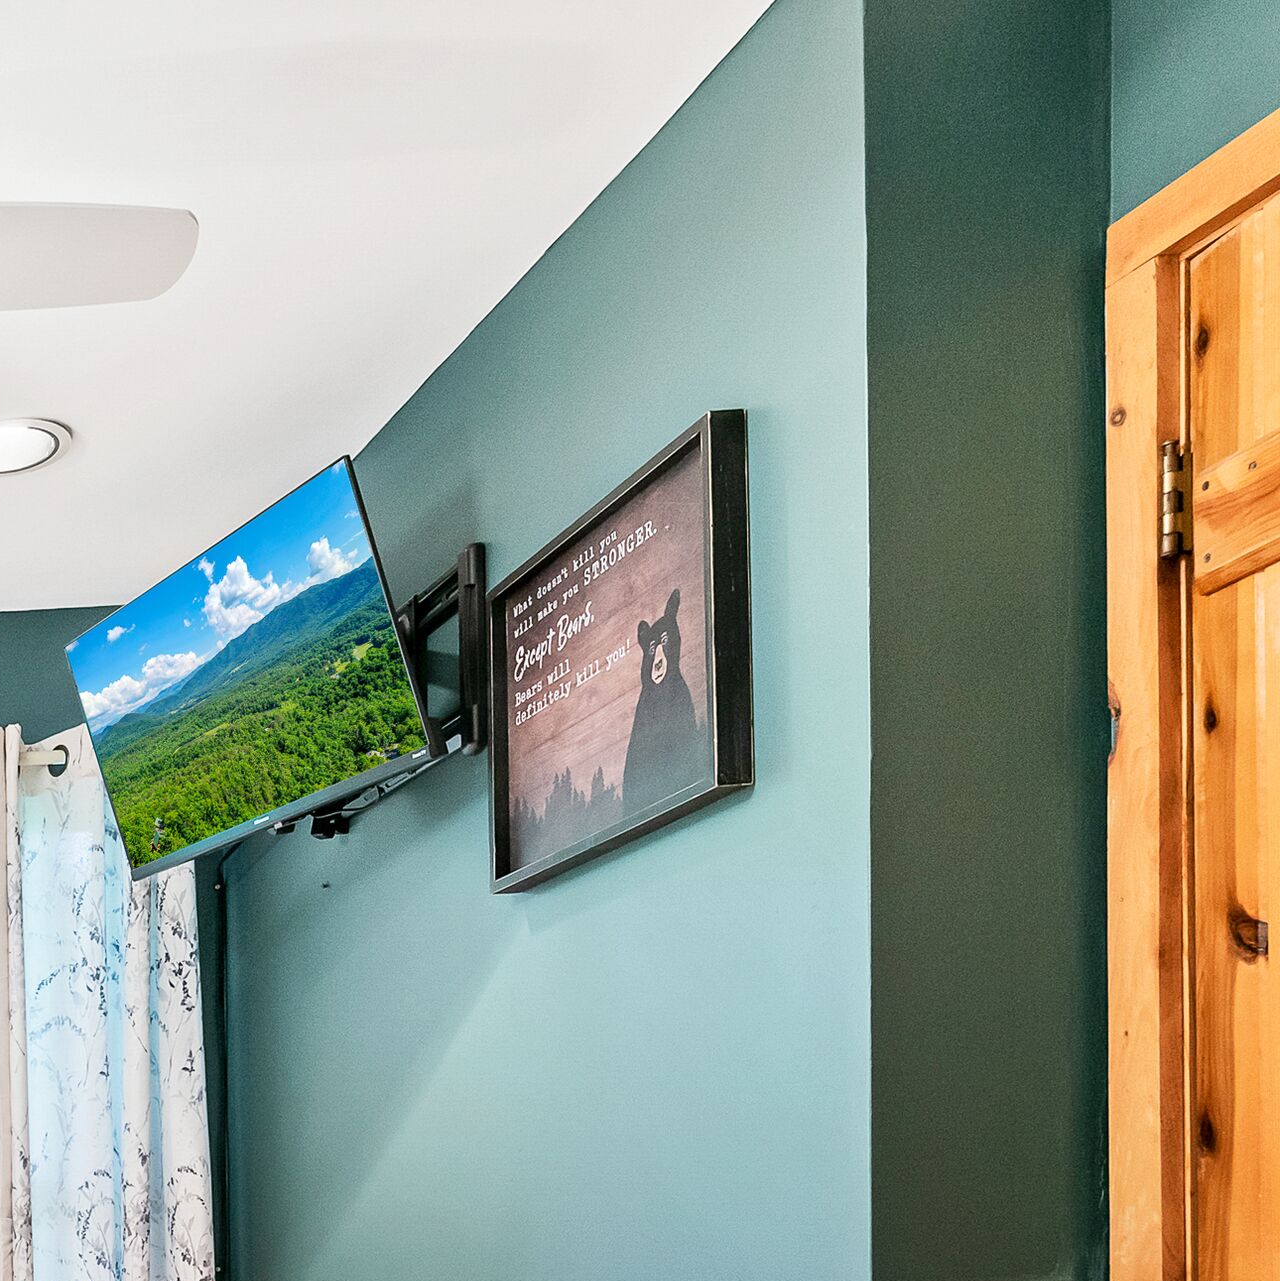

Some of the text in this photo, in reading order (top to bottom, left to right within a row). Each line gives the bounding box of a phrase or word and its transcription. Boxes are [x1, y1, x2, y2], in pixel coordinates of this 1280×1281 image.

[513, 530, 618, 618] What doesn't kill you
[514, 520, 658, 639] will make you STRONGER.
[514, 627, 556, 682] Except
[515, 638, 630, 726] definitely kill you!
[515, 659, 571, 707] Bears will
